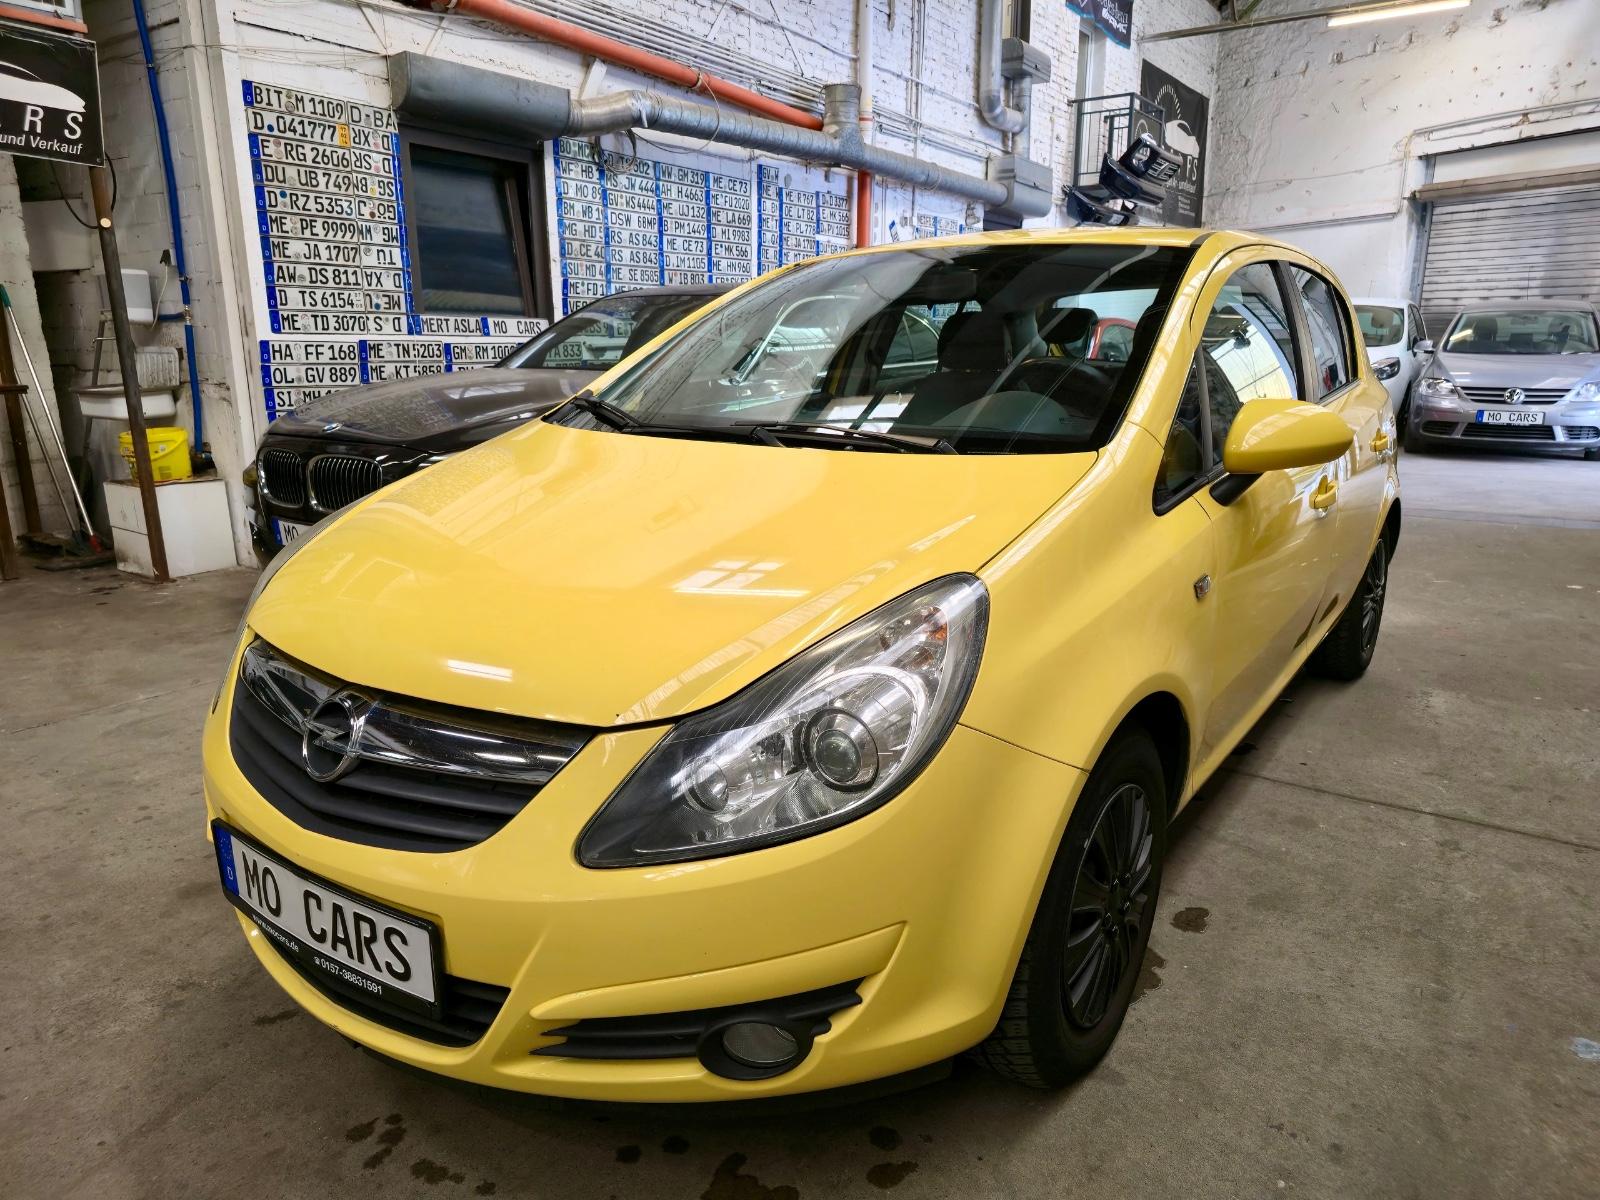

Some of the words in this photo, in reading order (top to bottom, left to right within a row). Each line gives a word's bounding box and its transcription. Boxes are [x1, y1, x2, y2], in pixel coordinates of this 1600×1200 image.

[254, 85, 283, 108] BIT
[294, 94, 306, 113] M
[310, 98, 344, 120] 1109
[252, 111, 264, 130] D
[276, 116, 337, 142] 041777
[0, 134, 26, 146] und
[30, 135, 83, 154] Verkauf
[261, 138, 273, 158] E
[284, 142, 307, 163] RG
[310, 147, 350, 168] 2606
[263, 164, 286, 184] DU
[297, 168, 320, 188] UB
[322, 172, 351, 192] 749
[581, 164, 594, 179] HB
[661, 165, 672, 180] WW
[678, 169, 688, 182] GM
[691, 171, 704, 185] 319
[606, 172, 618, 188] MS
[713, 176, 723, 189] ME
[728, 179, 737, 192] CE
[739, 182, 748, 194] 73
[562, 180, 569, 195] D
[576, 184, 588, 198] MO
[661, 184, 672, 197] AH
[678, 186, 682, 199] H
[685, 188, 704, 202] 4663
[267, 190, 278, 208] D
[290, 193, 312, 212] RZ
[314, 196, 353, 216] 5353
[608, 193, 618, 206] GV
[712, 193, 720, 206] ME
[564, 202, 574, 216] BM
[582, 205, 593, 219] WB
[663, 203, 673, 215] ME
[691, 206, 705, 219] 132
[712, 211, 721, 223] ME
[726, 212, 736, 224] LA
[738, 214, 750, 226] 669
[611, 212, 631, 227] DSW
[269, 216, 290, 234] ME
[300, 218, 320, 236] PE
[322, 220, 356, 240] 9999
[564, 223, 578, 236] MG
[584, 224, 596, 238] HD
[664, 220, 668, 232] B
[675, 222, 685, 234] PM
[687, 223, 706, 236] 1449
[611, 231, 622, 244] RS
[629, 233, 639, 246] AS
[642, 235, 658, 248] 843
[666, 238, 677, 250] ME
[683, 240, 692, 252] CE
[695, 241, 704, 253] 73
[272, 240, 291, 258] ME
[304, 243, 321, 260] JA
[325, 246, 358, 263] 1707
[567, 242, 572, 256] D
[580, 244, 592, 258] CE
[612, 249, 623, 262] RS
[630, 251, 640, 264] AS
[642, 252, 658, 265] 843
[715, 244, 719, 255] E
[725, 245, 734, 256] MK
[736, 246, 748, 258] 566
[568, 262, 578, 276] SU
[665, 255, 670, 267] D
[727, 261, 736, 272] HN
[276, 266, 296, 283] AW
[308, 267, 329, 284] DS
[332, 268, 361, 286] 811
[612, 268, 622, 281] ME
[629, 269, 638, 282] SE
[640, 270, 658, 283] 8585
[587, 283, 597, 296] FD
[278, 290, 288, 306] D
[298, 291, 317, 308] TS
[321, 292, 354, 309] 6154
[281, 314, 300, 330] ME
[311, 315, 329, 331] TD
[333, 316, 366, 331] 3070
[422, 318, 451, 332] MERT
[494, 320, 508, 334] MO
[517, 321, 542, 335] CARS
[271, 344, 294, 360] HA
[304, 344, 324, 360] FF
[328, 345, 357, 360] 168
[368, 344, 384, 358] ME
[394, 344, 410, 358] TN
[412, 344, 442, 358] 5203
[452, 346, 467, 360] GM
[476, 346, 488, 360] RM
[563, 344, 581, 358] 833
[273, 368, 294, 384] OL
[305, 367, 325, 383] GV
[330, 367, 357, 383] 889
[370, 365, 388, 380] ME
[395, 366, 410, 379] KT
[277, 390, 294, 407] SI
[1488, 412, 1502, 421] MO
[1509, 413, 1538, 423] CARS
[242, 850, 282, 918] MO
[303, 890, 411, 982] CARS
[321, 958, 382, 995] 0157-38831591
